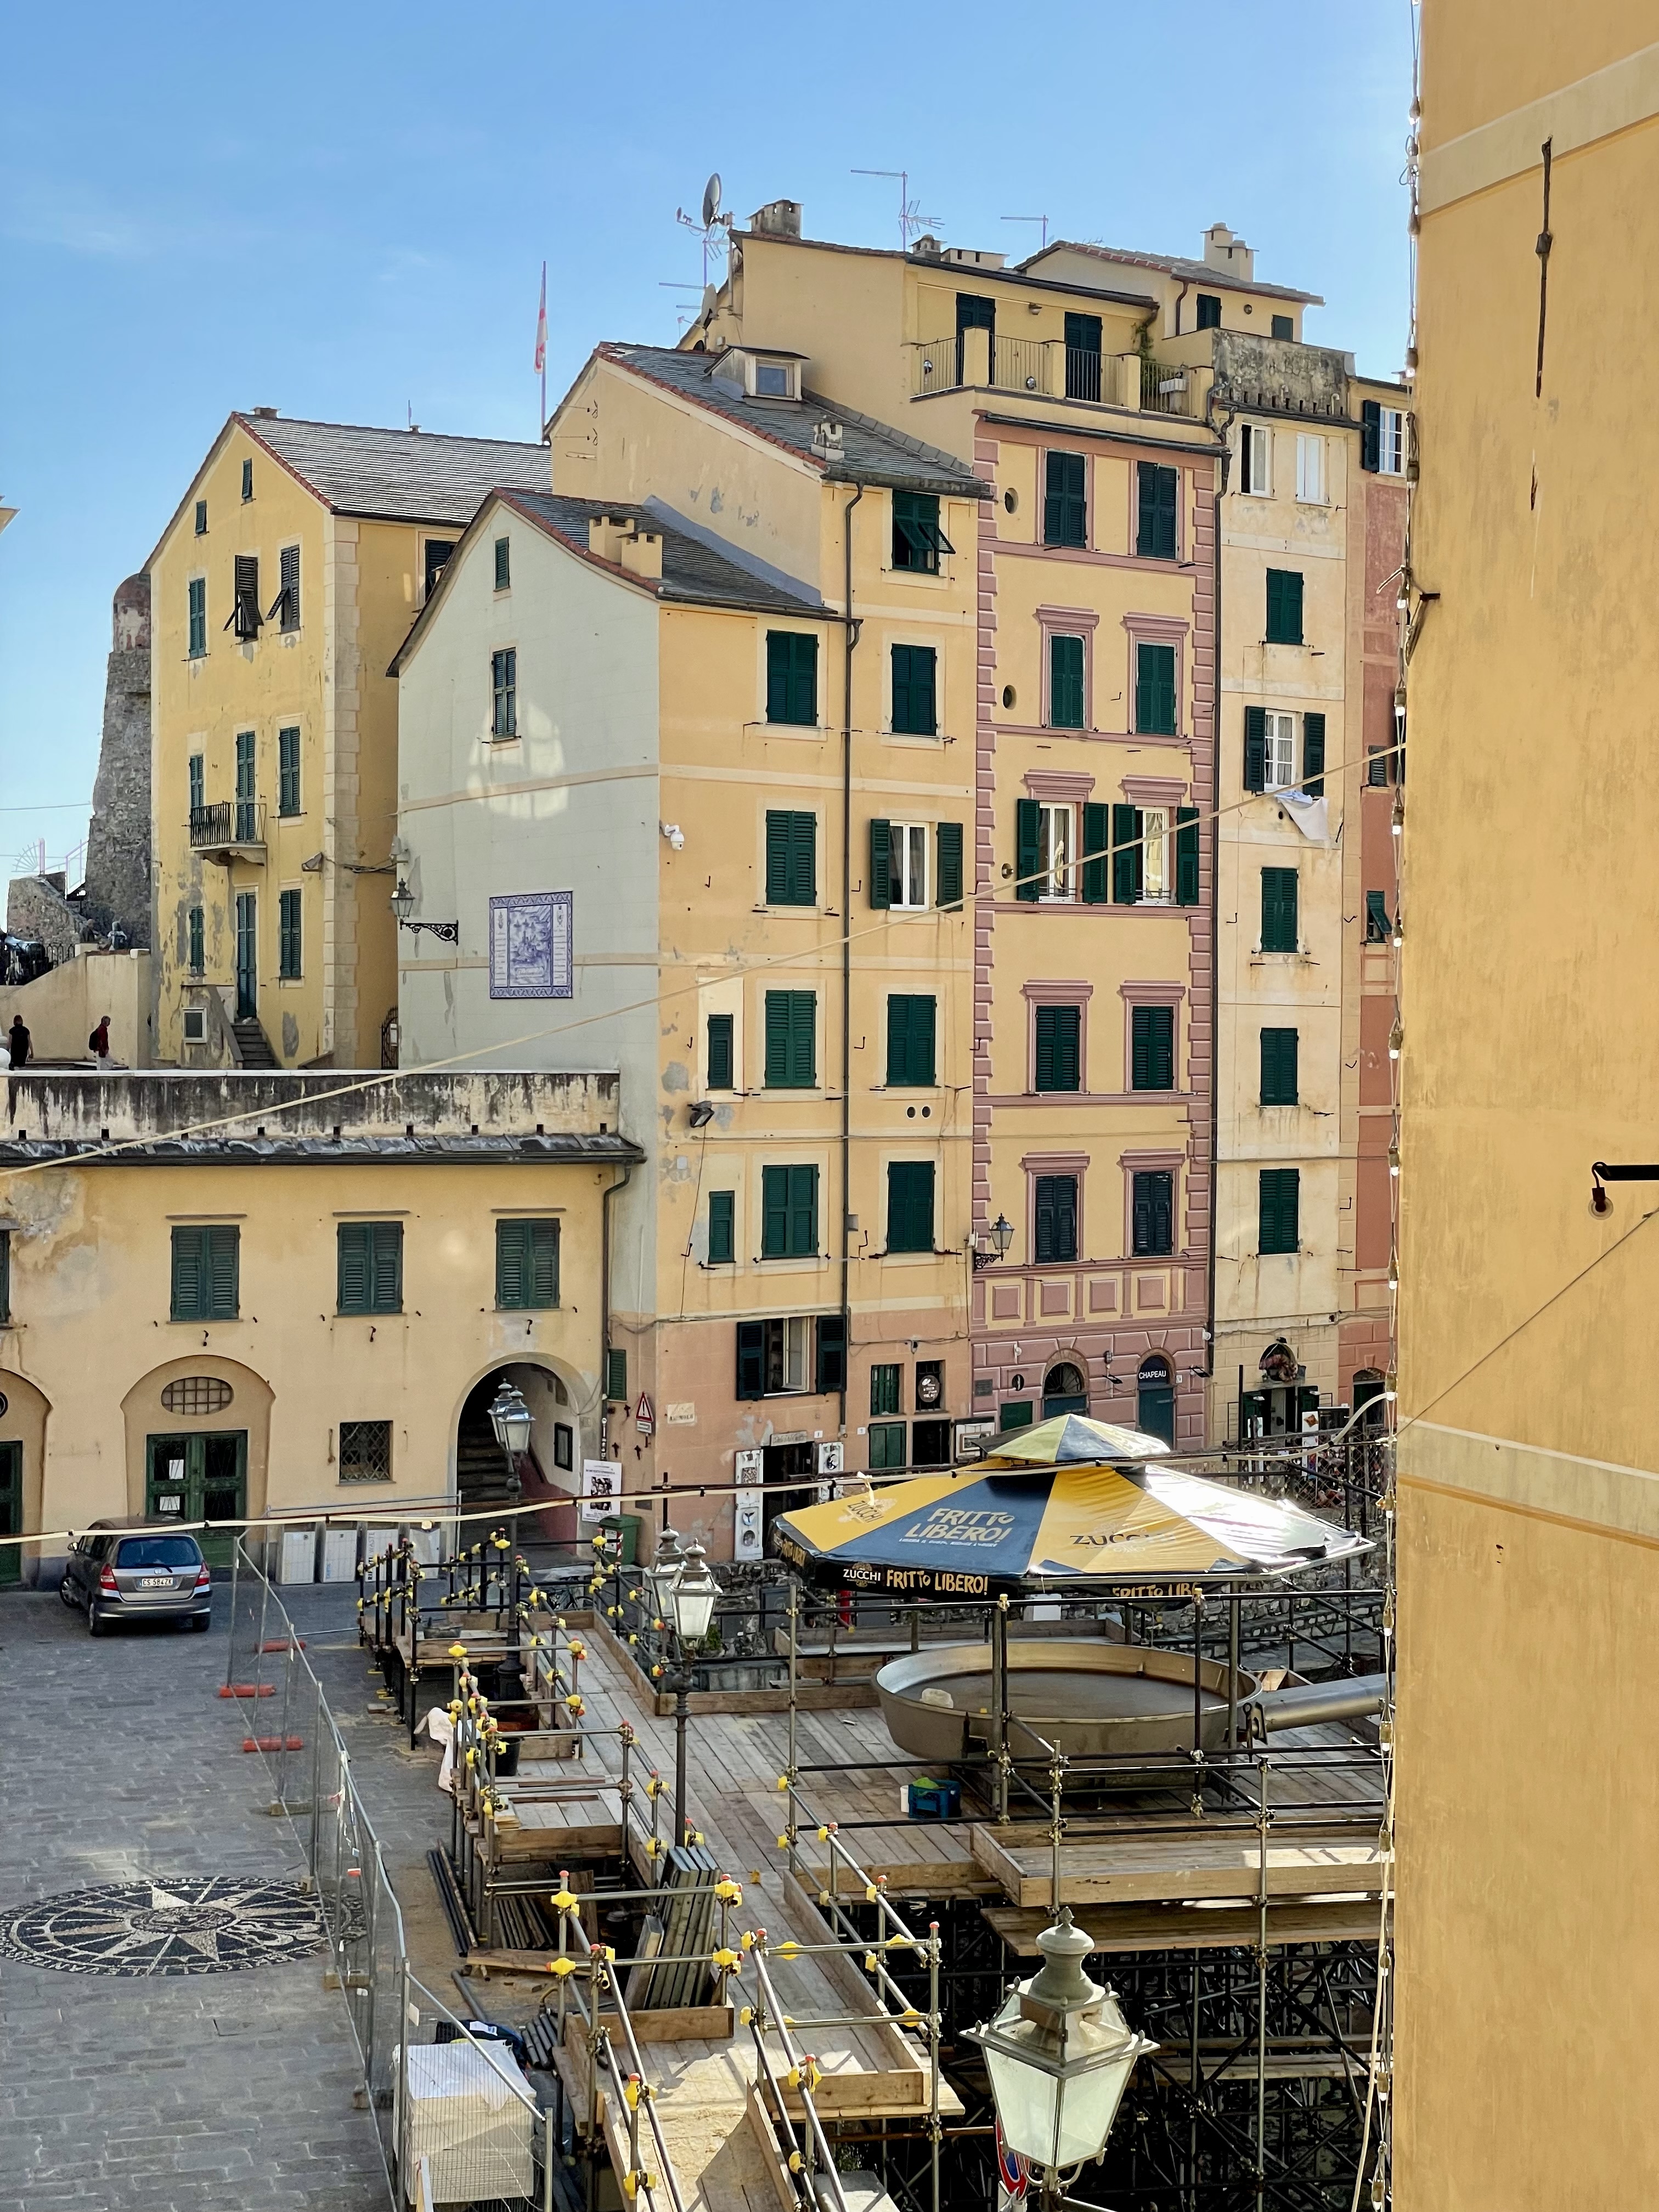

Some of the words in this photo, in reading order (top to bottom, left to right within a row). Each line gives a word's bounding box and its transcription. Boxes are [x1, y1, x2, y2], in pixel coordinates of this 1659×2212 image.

[1138, 1370, 1166, 1379] CHAPEAU
[847, 1500, 884, 1523] ZUCCHI
[927, 1508, 1015, 1526] FRITTO
[905, 1523, 1013, 1543] LIBERO!
[843, 1568, 881, 1581] ZUCCHI
[887, 1570, 931, 1589] FRITTO
[934, 1572, 989, 1596] LIBERO!
